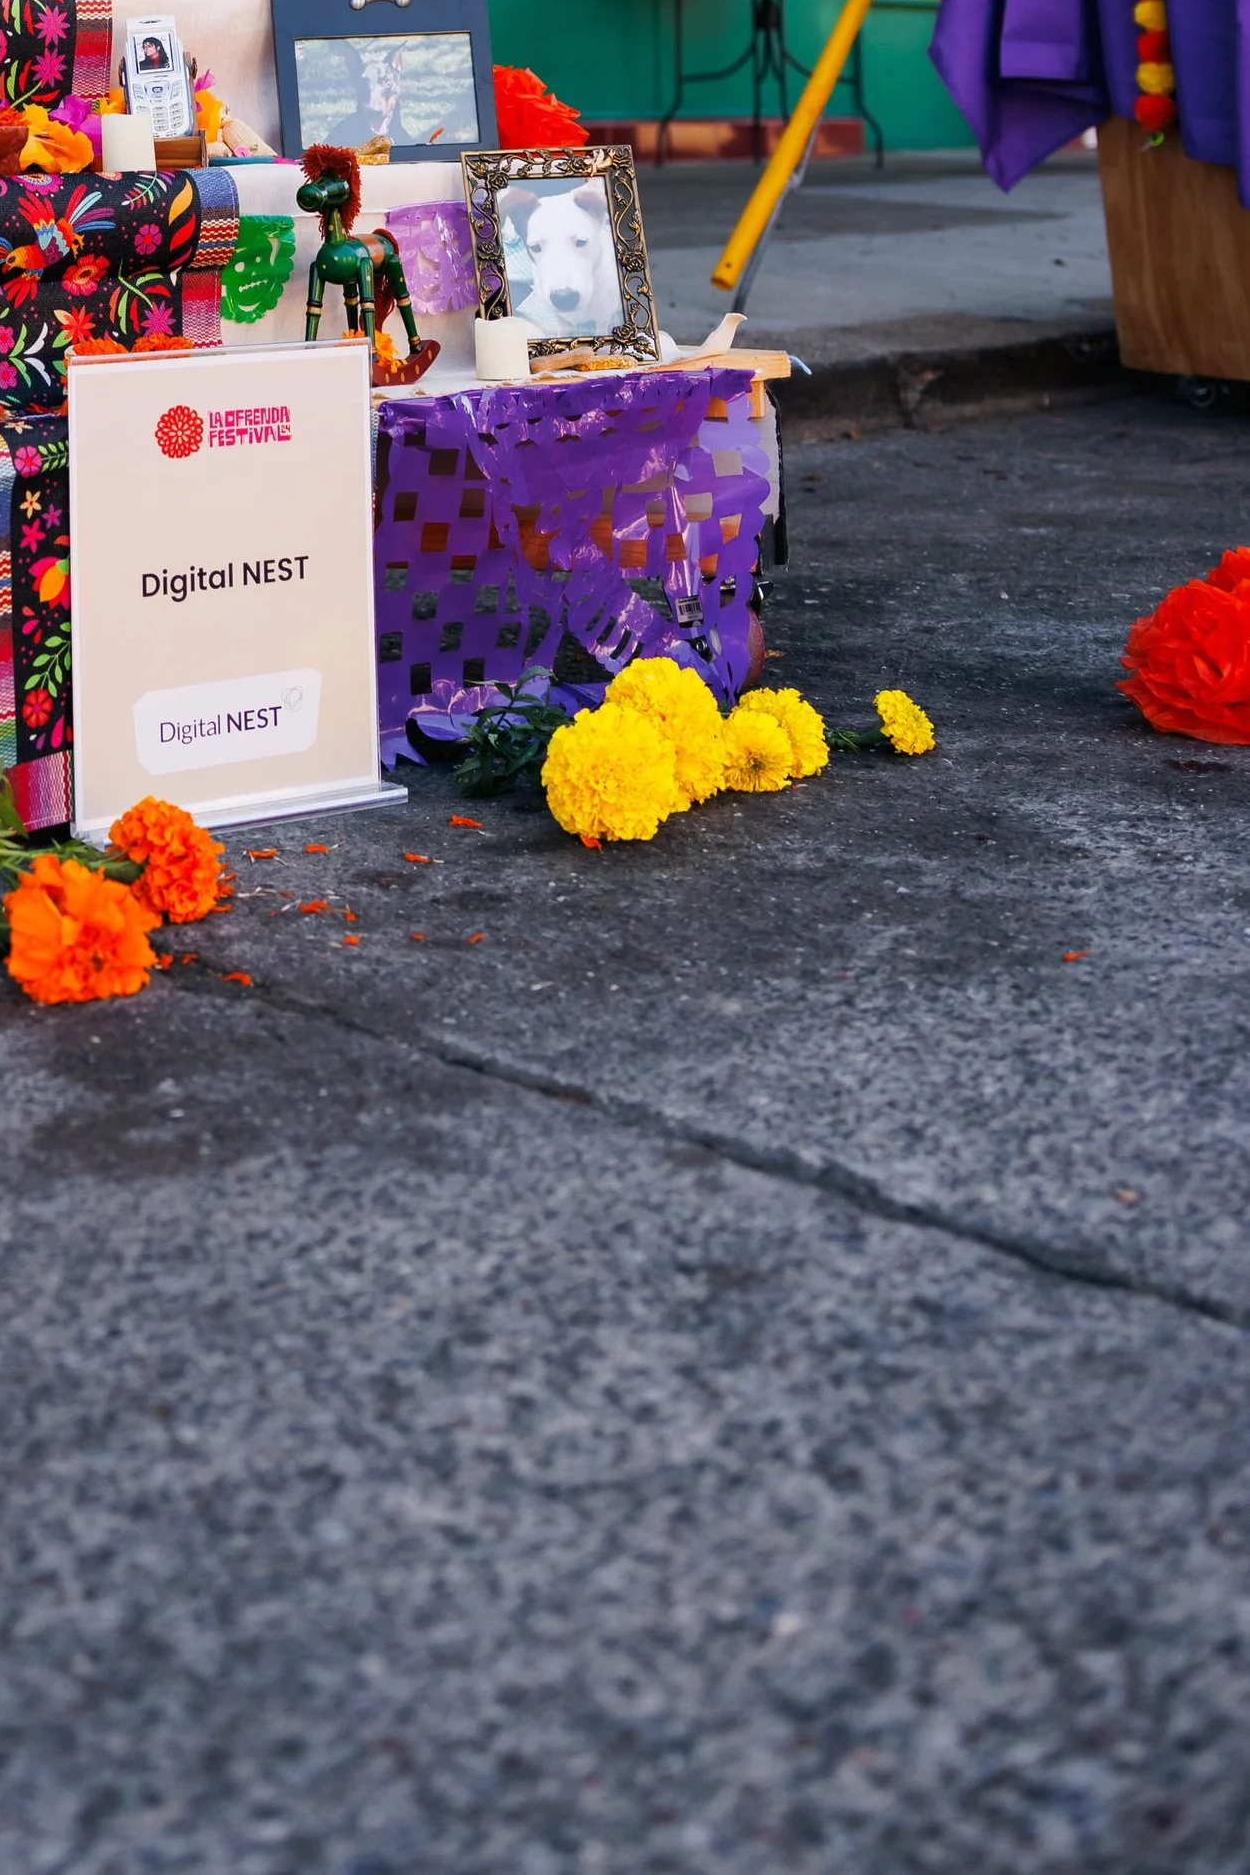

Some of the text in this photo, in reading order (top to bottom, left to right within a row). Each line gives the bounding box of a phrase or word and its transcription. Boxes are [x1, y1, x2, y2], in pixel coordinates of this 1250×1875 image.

[209, 406, 290, 429] LA OFRENDA
[142, 555, 310, 603] Digital NEST
[159, 706, 283, 745] Digital NEST
